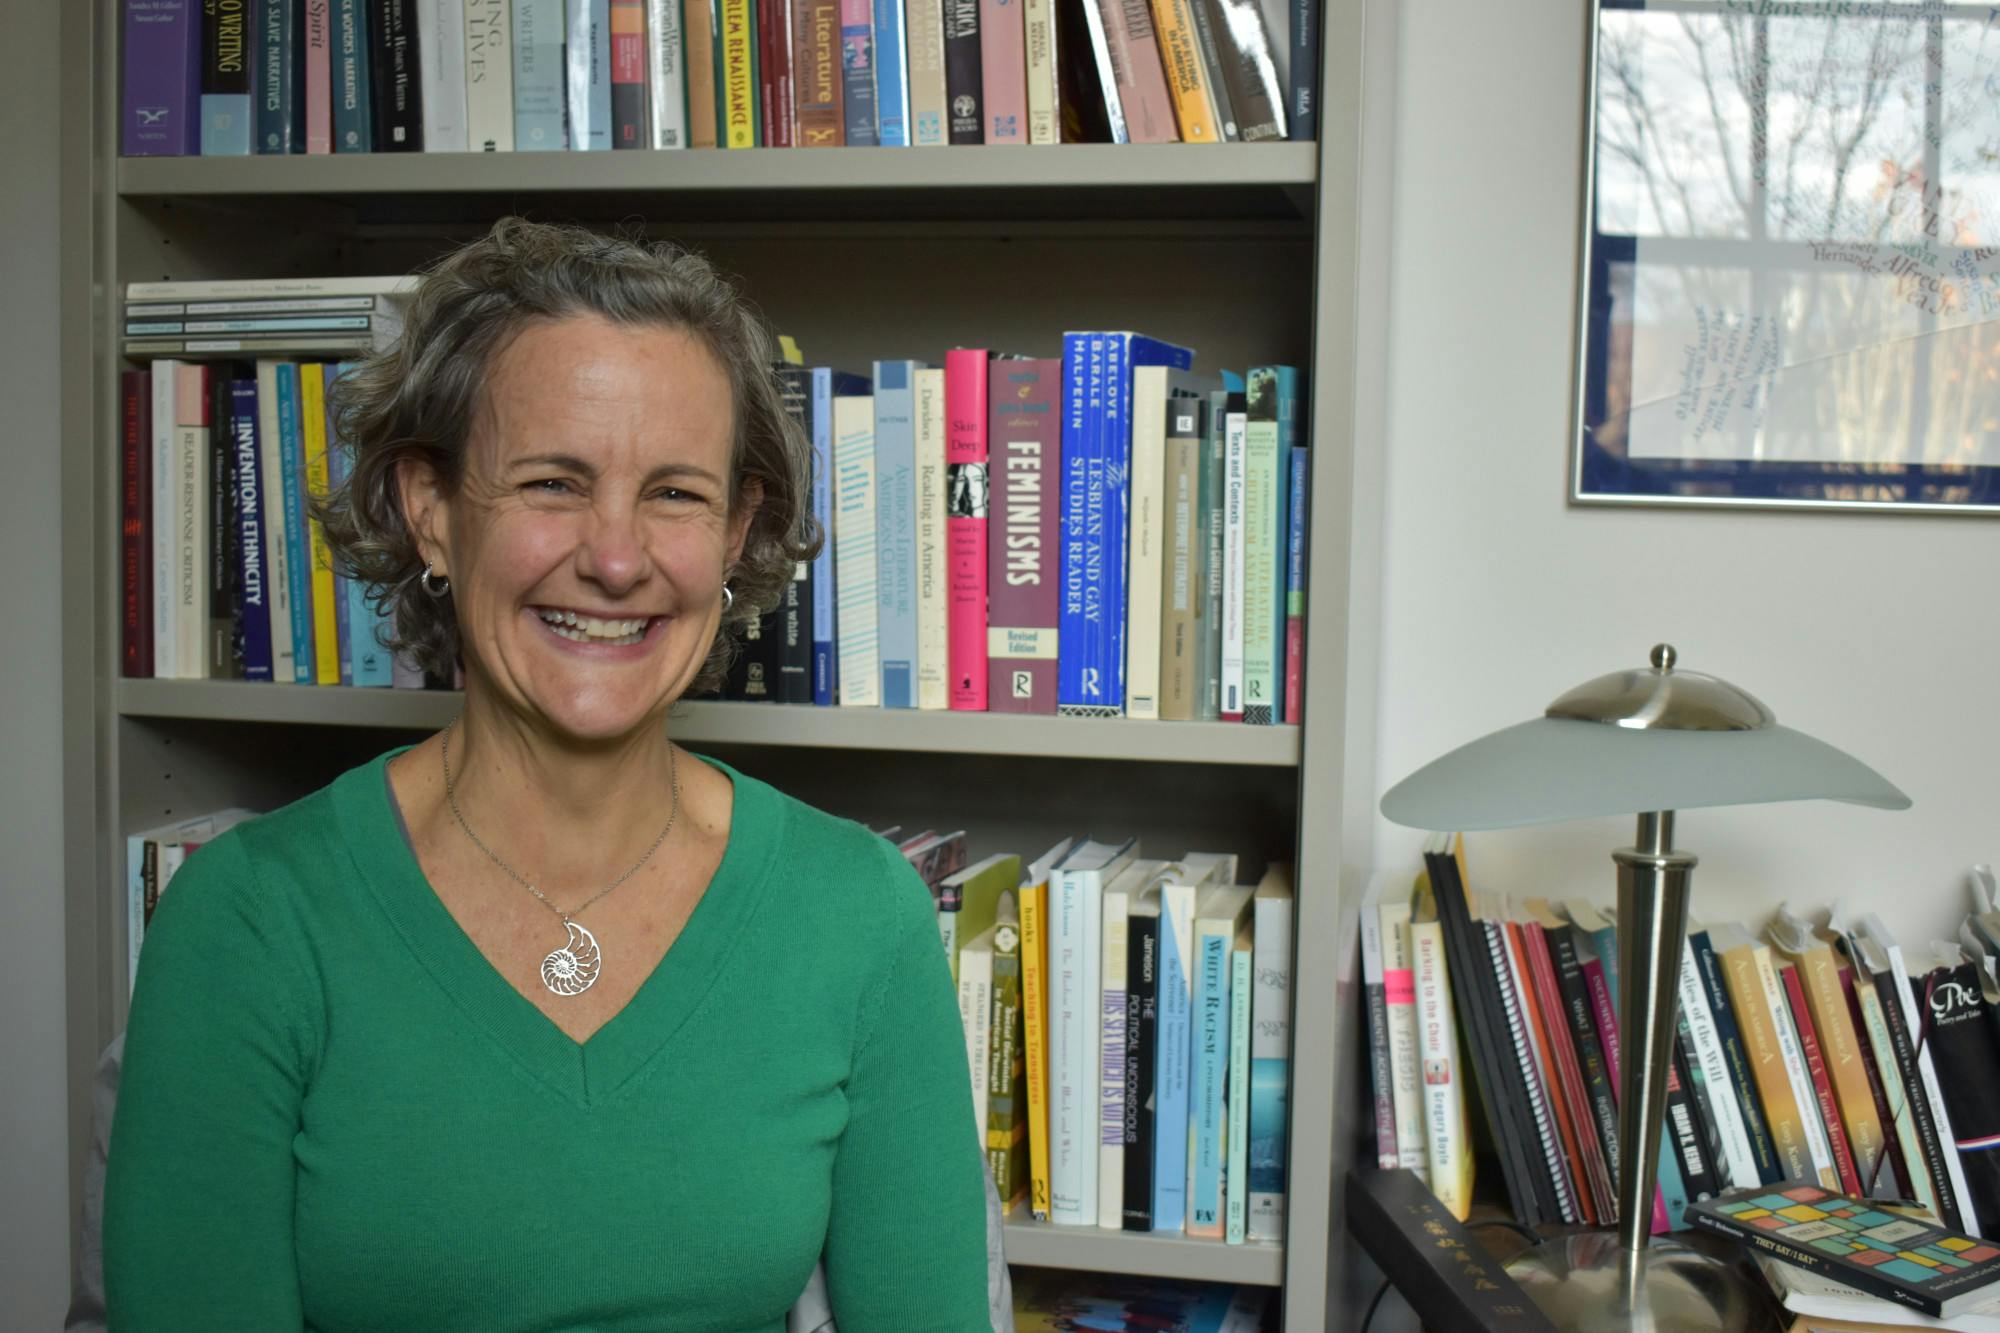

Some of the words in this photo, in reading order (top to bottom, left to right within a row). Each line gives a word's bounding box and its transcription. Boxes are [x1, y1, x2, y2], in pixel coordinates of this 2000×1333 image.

[218, 13, 243, 73] WRITING
[267, 7, 281, 42] SLAVE
[308, 1, 327, 49] Spirit
[521, 4, 535, 75] WRITERS
[1168, 29, 1178, 43] IN
[469, 18, 487, 84] LIVES
[661, 30, 679, 76] Writers
[815, 5, 835, 104] Literature
[1171, 44, 1190, 94] AMERICA
[1181, 51, 1201, 91] ETHNIC
[267, 46, 281, 112] NARRATIVES
[344, 57, 357, 111] NARRATIVES
[728, 38, 748, 127] RENAISSANCE
[800, 48, 813, 104] Cultures
[1299, 89, 1311, 116] MLA
[1072, 339, 1086, 429] HALPERIN
[1090, 339, 1102, 409] BARALE
[1106, 339, 1120, 419] ABELOVE
[127, 396, 138, 416] THE
[921, 388, 935, 441] Davidson
[127, 421, 138, 445] FIRE
[952, 440, 981, 451] Deep
[953, 421, 978, 432] Skin
[1230, 430, 1243, 454] Texts
[183, 432, 195, 542] READER-RESPONSE
[237, 422, 257, 513] INVENTION
[1230, 455, 1242, 479] and
[920, 464, 936, 520] Reading
[1068, 456, 1084, 537] STUDIES
[1087, 457, 1104, 536] LESBIAN
[1229, 480, 1242, 525] Contexts
[1246, 469, 1258, 544] CRITICISM
[921, 523, 935, 537] in
[1006, 441, 1041, 587] FEMINISMS
[1175, 501, 1189, 554] INTERPRET
[1210, 507, 1224, 535] TEXTS
[183, 545, 194, 606] CRITICISM
[241, 520, 261, 606] ETHNICITY
[921, 541, 936, 599] America
[1067, 540, 1083, 615] READER
[1086, 540, 1101, 581] AND
[1209, 549, 1223, 597] CONTEXTS
[1245, 552, 1258, 584] AND
[787, 582, 800, 607] and
[1174, 555, 1188, 611] LITERATURE
[127, 593, 138, 628] WARD
[1084, 585, 1100, 623] GAY
[1244, 588, 1257, 647] THEORY
[787, 609, 800, 647] white
[1007, 630, 1038, 641] Revised
[1008, 641, 1037, 652] Edition
[1024, 906, 1036, 944] hooks
[1063, 947, 1073, 965] The
[1143, 934, 1155, 983] Jameson
[1167, 958, 1177, 971] the
[1205, 939, 1222, 992] WHITE
[1419, 937, 1437, 982] Barking
[991, 988, 1003, 998] in
[1026, 966, 1039, 1022] Teaching
[1166, 973, 1178, 1014] Scrivener
[1178, 977, 1188, 1015] America
[1425, 985, 1437, 998] to
[1711, 980, 1720, 992] and
[1735, 959, 1757, 999] ANGELS
[1103, 989, 1125, 1015] THIS
[1143, 997, 1153, 1019] THE
[1371, 995, 1385, 1047] ELEMENTS
[1426, 1000, 1438, 1019] the
[1572, 997, 1589, 1031] WHAT
[1591, 975, 1612, 1029] INCLUSIVE
[1693, 1006, 1708, 1023] of
[1713, 992, 1725, 1010] Early
[1749, 1001, 1758, 1013] IN
[991, 998, 1003, 1046] American
[1028, 1024, 1039, 1038] to
[1103, 1017, 1124, 1040] SEX
[1128, 994, 1139, 1052] POLITICAL
[1205, 996, 1222, 1054] RACISM
[1427, 1022, 1441, 1052] Choir
[1696, 1024, 1713, 1047] the
[1752, 1015, 1776, 1065] AMERICA
[1774, 1005, 1789, 1035] Writing
[1783, 1036, 1794, 1055] with
[991, 1047, 1003, 1093] Thought
[1002, 1040, 1013, 1094] Darwinism
[1027, 1041, 1041, 1105] Transgress
[1103, 1042, 1124, 1082] WHICH
[1702, 1050, 1724, 1083] Will
[1726, 1037, 1743, 1071] Approaches
[1062, 1084, 1073, 1112] Black
[1102, 1086, 1123, 1099] IS
[1126, 1056, 1138, 1143] UNCONSCIOUS
[1376, 1056, 1390, 1106] ACADEMIC
[1739, 1079, 1754, 1106] Teaching
[1062, 1116, 1072, 1134] and
[1102, 1103, 1122, 1124] NOT
[1380, 1107, 1392, 1136] STYLE
[1431, 1091, 1449, 1134] Gregory
[1671, 1103, 1696, 1133] IBRAM
[1802, 1034, 1822, 1076] SULA
[1817, 1089, 1833, 1119] Toni
[1826, 1121, 1851, 1178] Morrison
[1896, 1034, 1906, 1058] WHAT
[1917, 1114, 1935, 1156] AMERICAN
[1931, 1157, 1952, 1210] LITERATURE?
[1101, 1125, 1122, 1148] ONE
[1435, 1135, 1451, 1166] Boyle
[1779, 1117, 1795, 1145] Tony
[1857, 1119, 1873, 1145] Tony
[997, 1150, 1006, 1185] Richard
